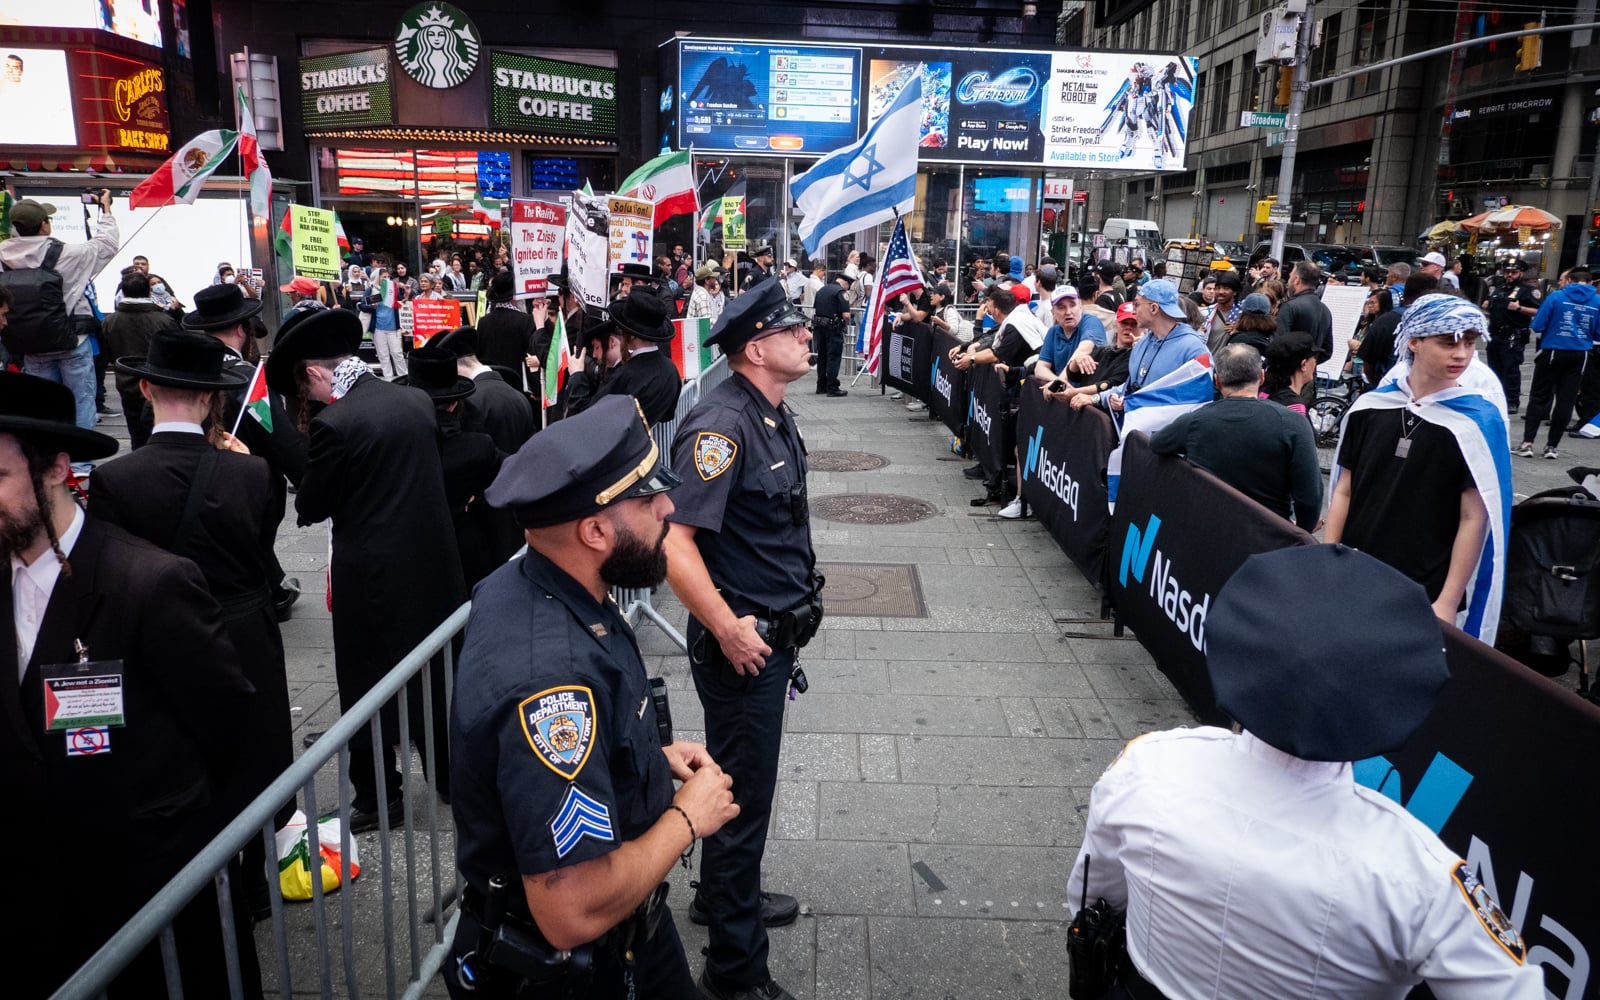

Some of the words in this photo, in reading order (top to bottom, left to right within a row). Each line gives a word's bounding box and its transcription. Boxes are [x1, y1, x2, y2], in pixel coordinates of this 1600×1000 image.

[302, 63, 386, 90] STARBUCKS
[496, 67, 615, 100] STARBUCKS
[1062, 81, 1086, 92] METAL
[115, 69, 163, 121] CARLO'S
[316, 90, 372, 113] COFFEE
[1061, 92, 1088, 102] ROBOT
[519, 96, 593, 121] COFFEE
[1478, 104, 1505, 115] REWRITE
[1251, 114, 1285, 128] Broadway
[1051, 125, 1071, 133] Strike
[1072, 126, 1101, 135] Freedom
[120, 129, 145, 147] BAKE
[145, 132, 169, 150] SHOP
[958, 136, 989, 152] Play
[993, 137, 1029, 150] Now!
[1050, 135, 1077, 144] Gundam
[1050, 151, 1087, 161] Available
[1088, 152, 1096, 161] in
[1098, 153, 1120, 162] Store
[523, 205, 535, 218] The
[299, 223, 310, 231] WAR
[309, 236, 322, 244] FREE
[522, 229, 534, 242] The
[302, 244, 329, 253] PALESTINE!
[515, 247, 543, 264] Ignited
[547, 247, 558, 260] Fire
[302, 255, 318, 264] STOP
[319, 257, 330, 266] ICE!
[935, 367, 952, 407] Nasdaq
[709, 435, 729, 447] POLICE
[1038, 447, 1079, 522] Nasdaq
[1150, 549, 1209, 656] Nasd
[539, 692, 576, 708] POLICE
[529, 701, 588, 726] DEPARTMENT
[572, 744, 587, 765] NEW
[582, 716, 592, 743] YORK
[533, 733, 551, 755] CITY
[549, 753, 562, 765] OF
